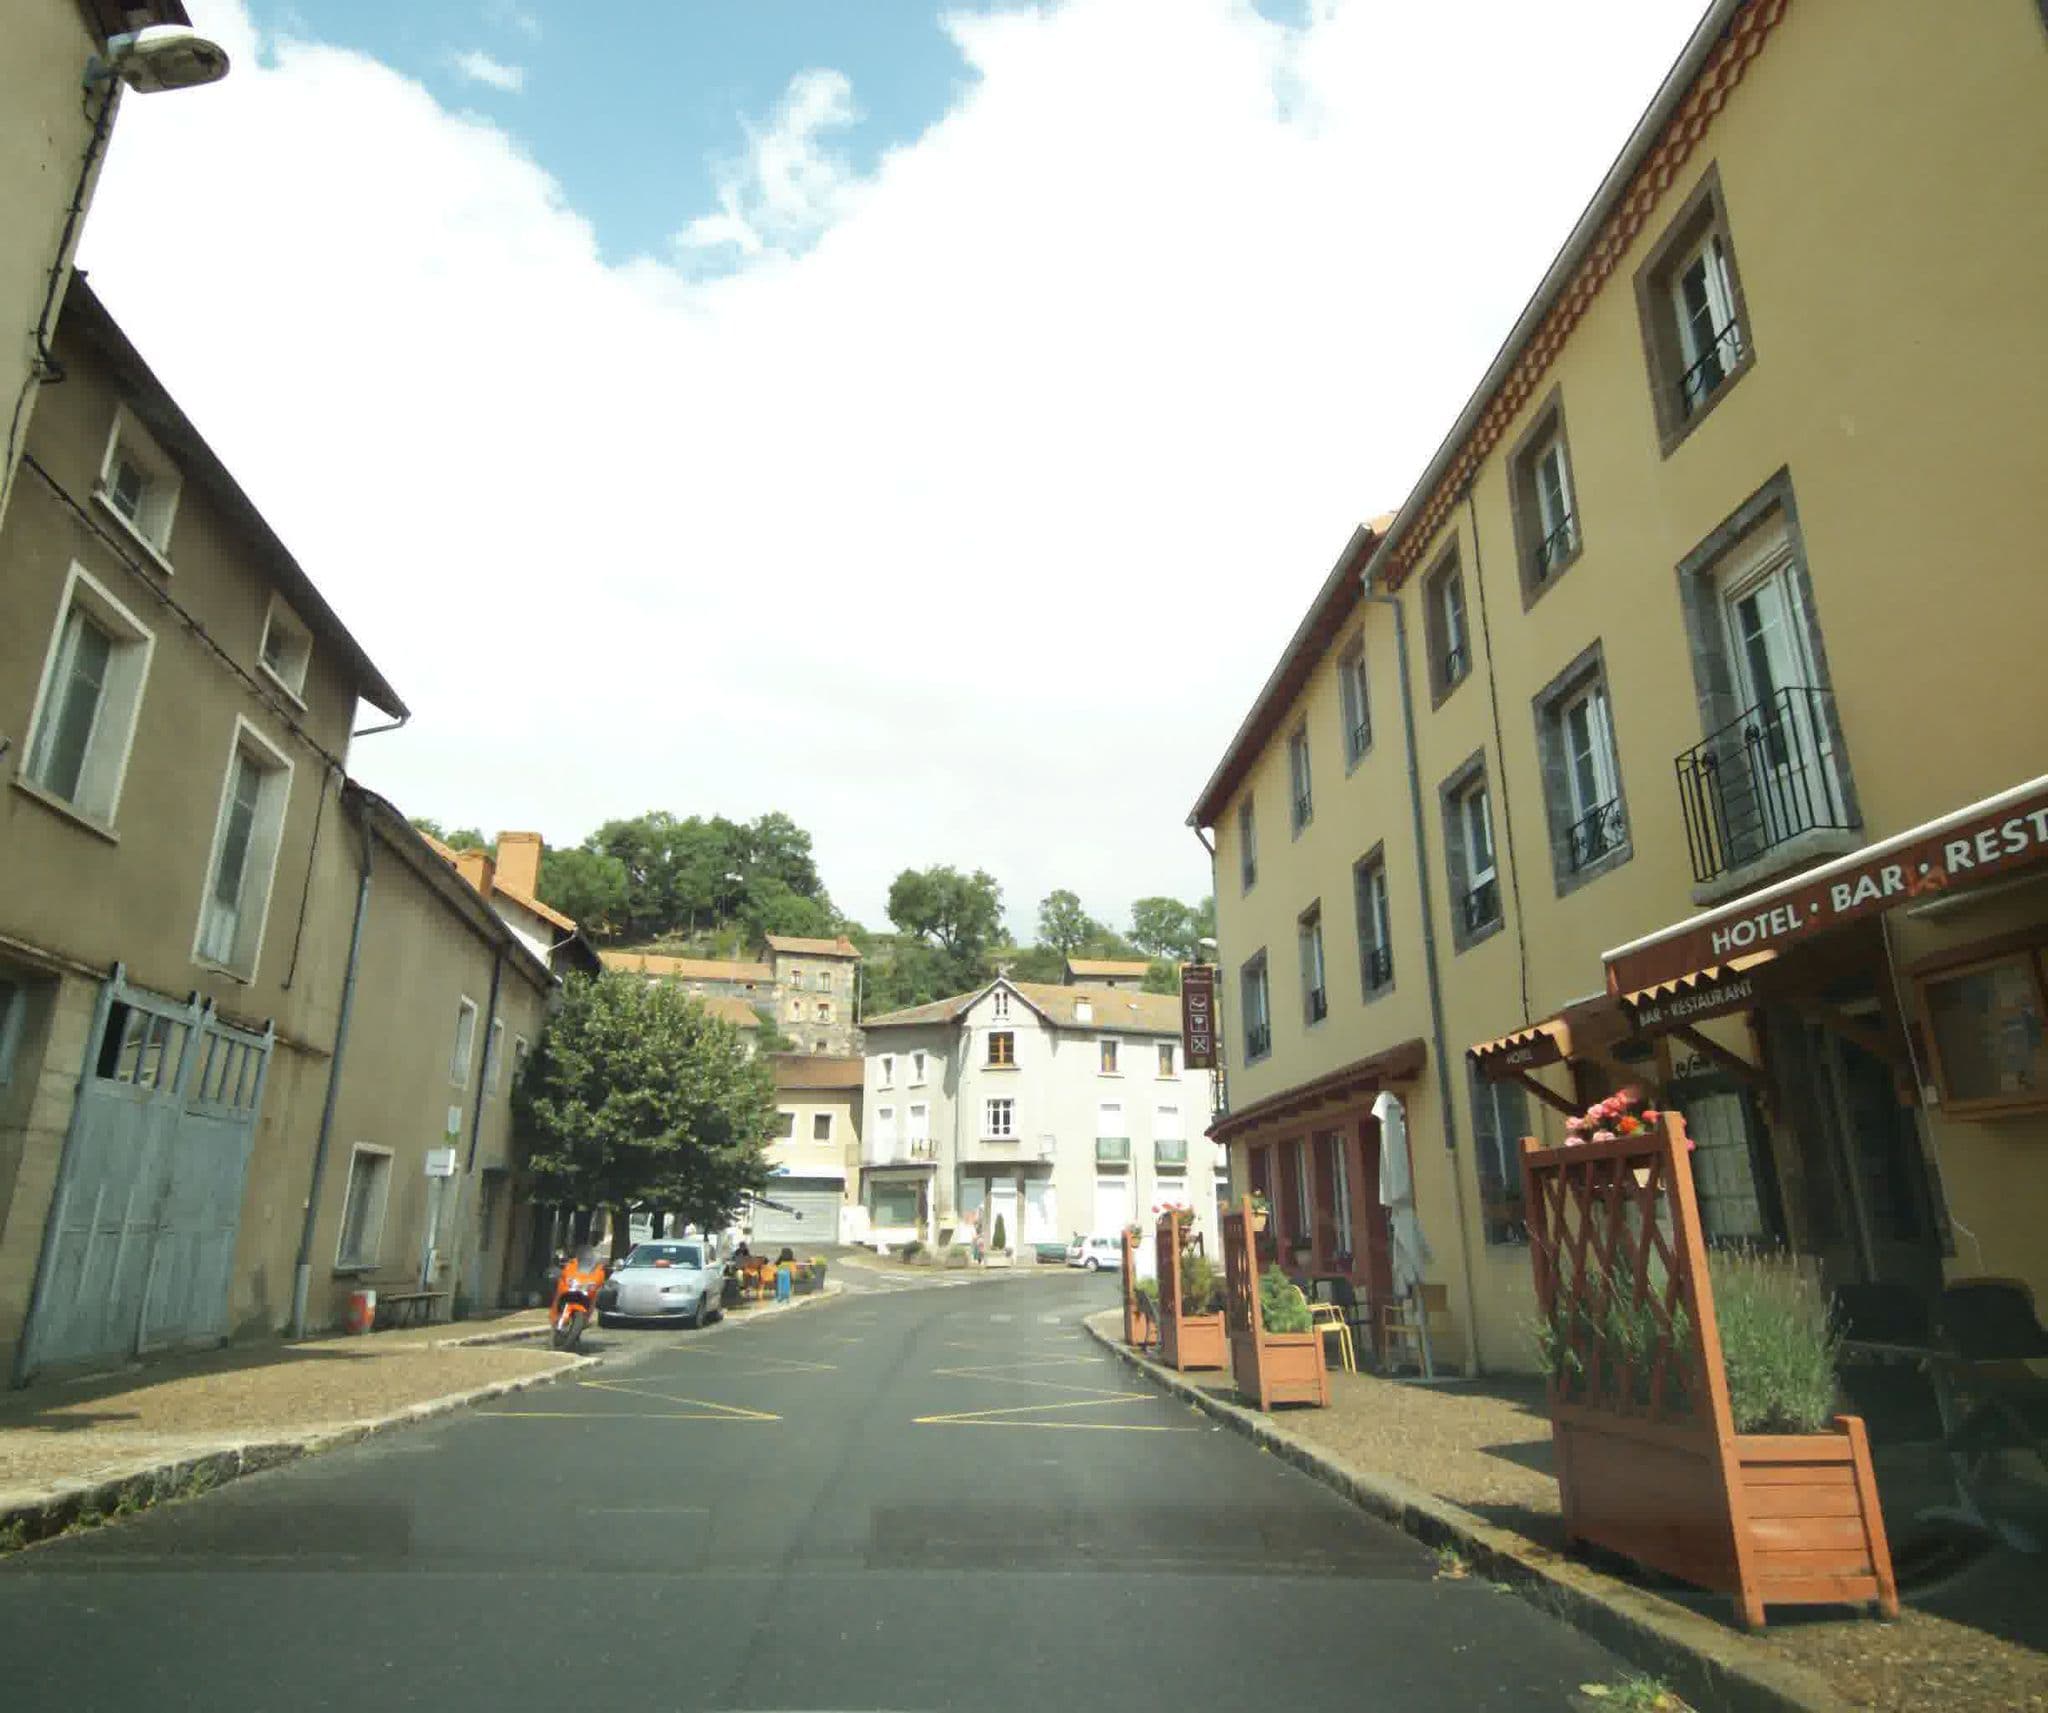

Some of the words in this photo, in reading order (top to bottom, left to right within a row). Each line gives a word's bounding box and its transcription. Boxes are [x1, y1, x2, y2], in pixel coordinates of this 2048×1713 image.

[1711, 904, 1803, 955] HOTEL
[1831, 864, 1905, 913] BAR
[1944, 807, 2048, 874] REST
[1671, 978, 1753, 1017] RESTAURANT
